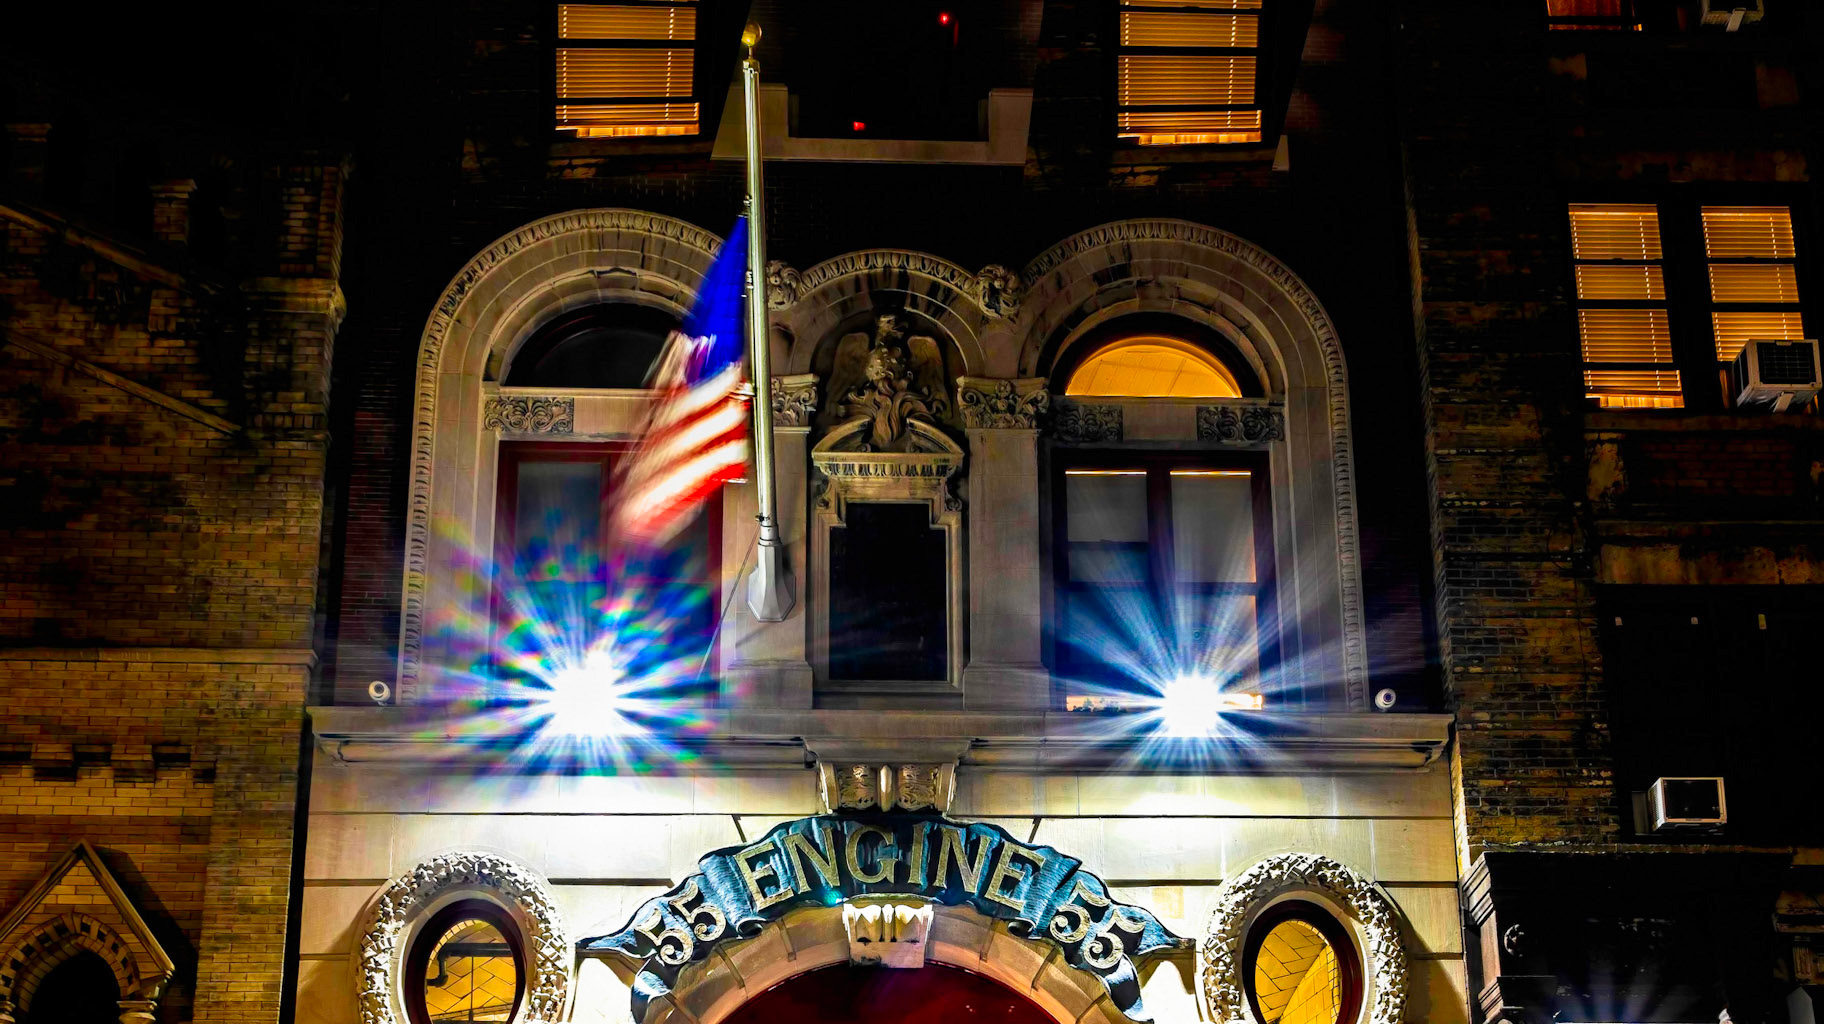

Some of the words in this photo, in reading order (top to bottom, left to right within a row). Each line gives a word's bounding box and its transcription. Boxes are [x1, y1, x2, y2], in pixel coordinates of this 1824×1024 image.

[634, 880, 726, 965] 55
[733, 824, 1046, 912] ENGINE
[1050, 880, 1147, 969] 55
